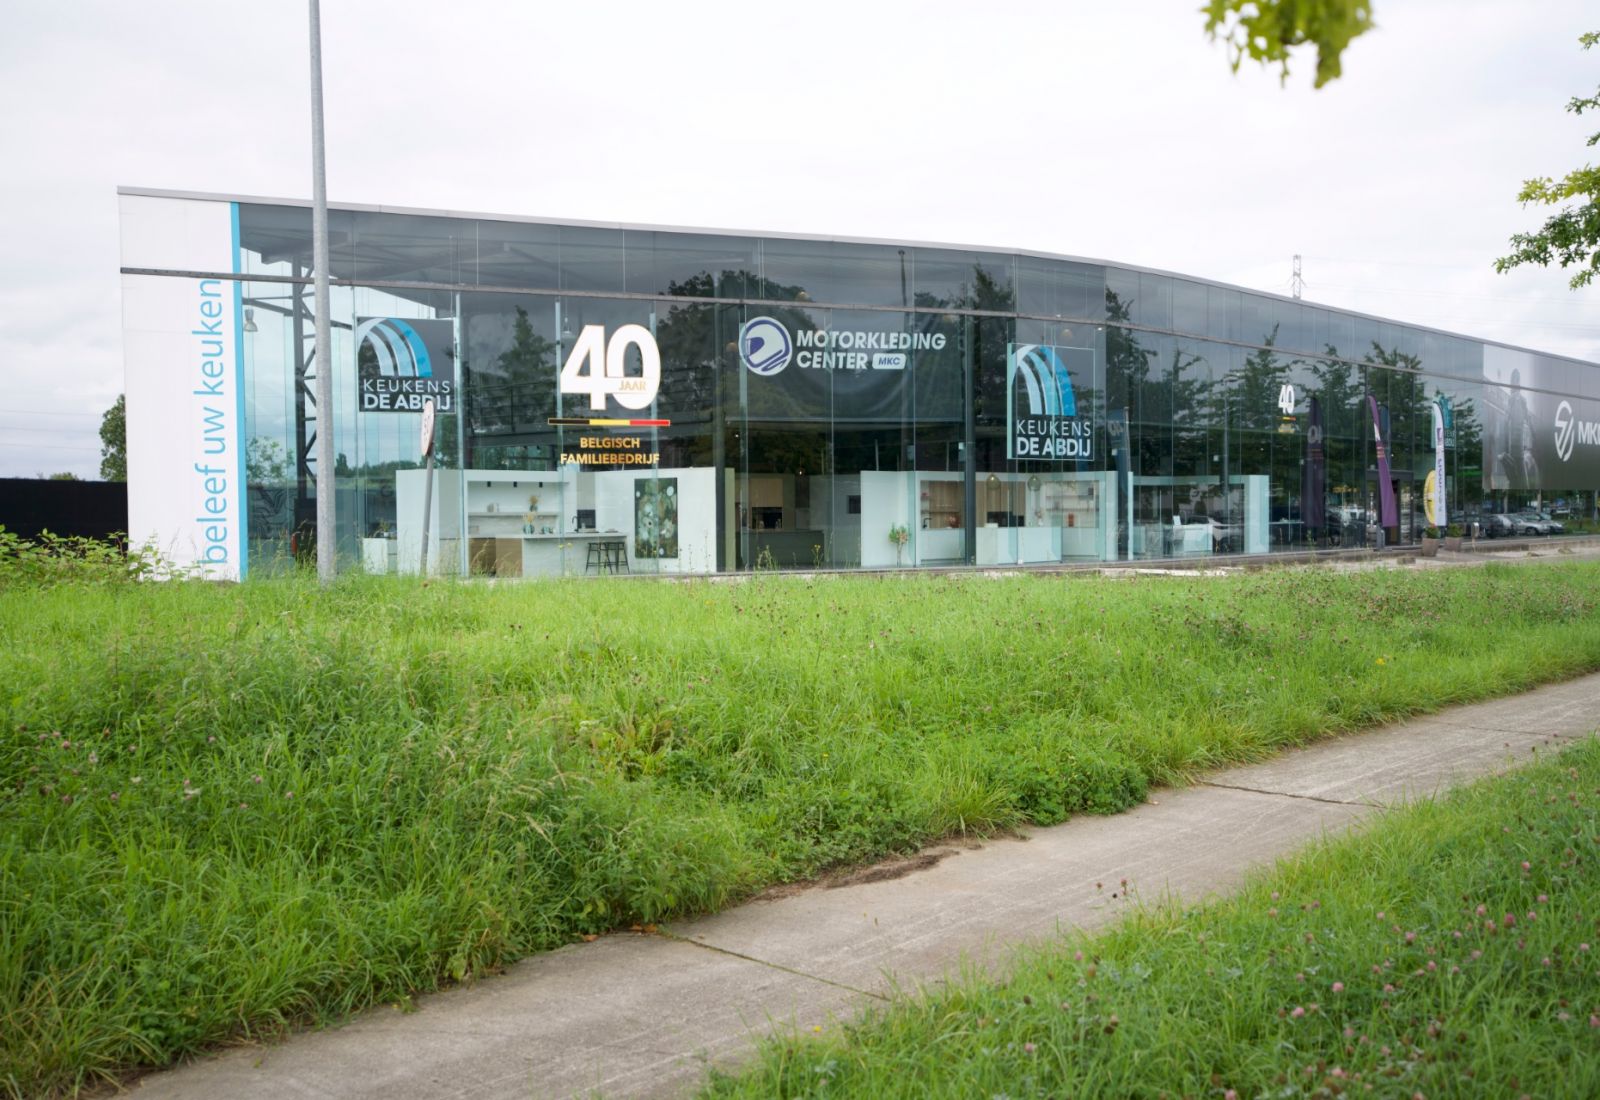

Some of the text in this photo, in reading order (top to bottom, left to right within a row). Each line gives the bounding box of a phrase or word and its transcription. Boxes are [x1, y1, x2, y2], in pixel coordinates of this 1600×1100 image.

[796, 330, 946, 350] MOTORKLEDING
[560, 324, 661, 410] 40
[796, 351, 901, 369] CENTER MKC
[363, 379, 451, 394] KEUKENS
[619, 380, 647, 391] JAAR
[364, 393, 391, 409] DE
[1278, 384, 1295, 415] 40
[191, 280, 228, 564] beleef uw keuken
[1016, 420, 1091, 436] KEUKENS
[1578, 421, 1600, 446] MK
[580, 437, 640, 449] BELGISCH
[1016, 437, 1091, 457] DE ABDIJ
[560, 453, 660, 465] FAMILIEBEDRIJF
